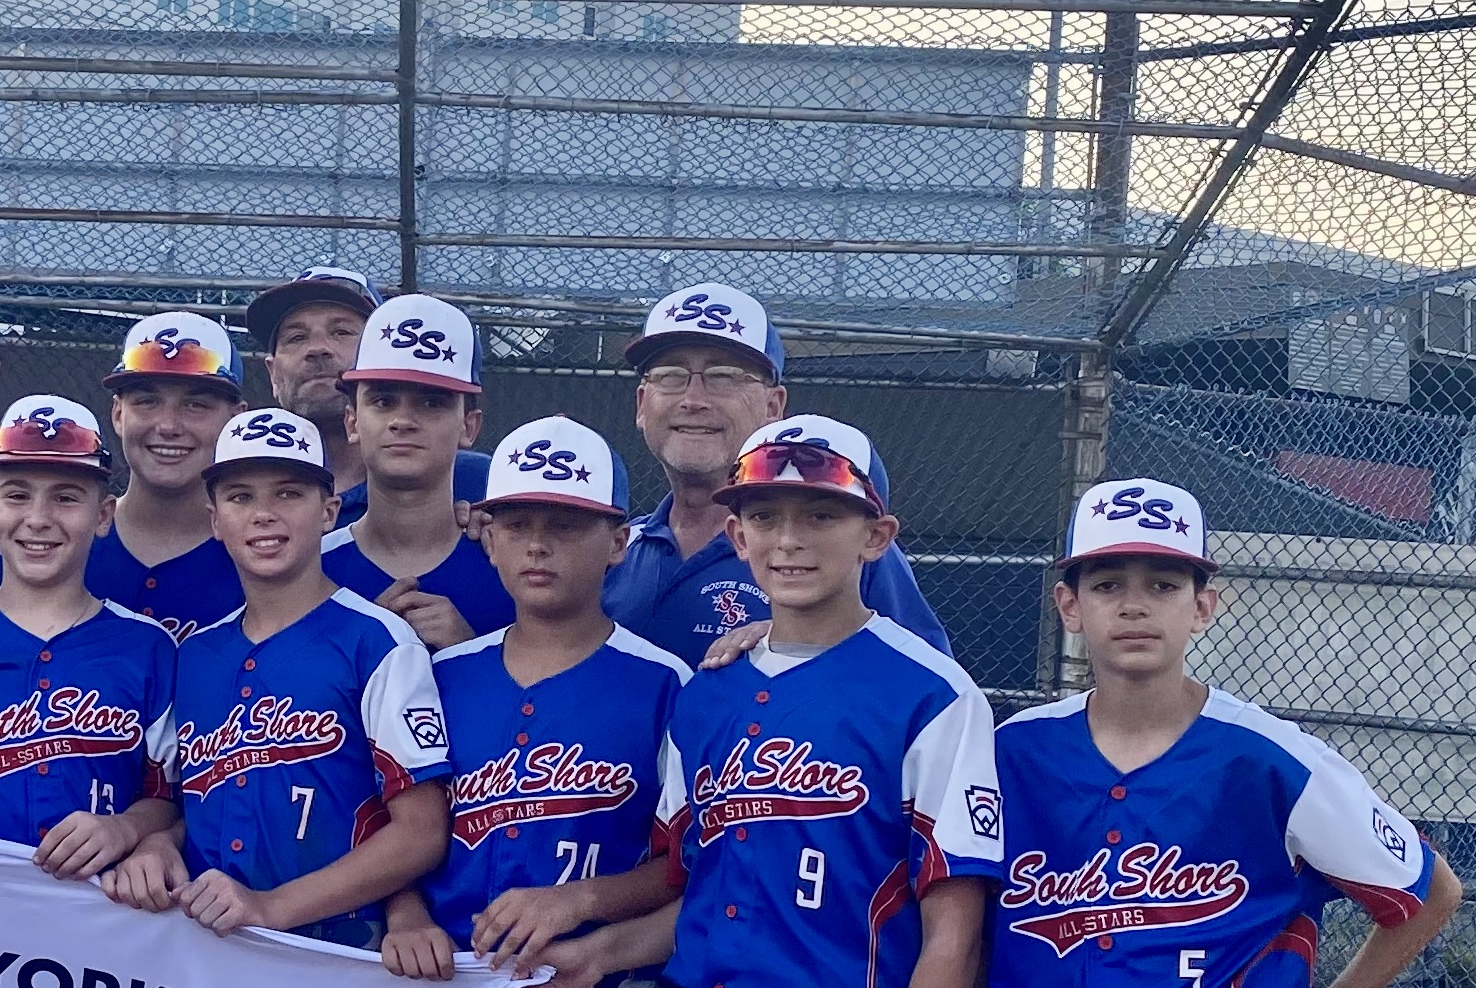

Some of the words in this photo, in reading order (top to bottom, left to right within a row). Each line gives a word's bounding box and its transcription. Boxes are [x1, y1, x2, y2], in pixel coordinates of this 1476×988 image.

[675, 293, 732, 330] SS
[391, 318, 445, 360] SS
[244, 414, 298, 448] SS
[518, 439, 578, 482] SS
[1107, 487, 1173, 530] SS
[700, 581, 738, 595] SOUTH
[693, 623, 714, 634] ALL
[42, 687, 142, 741] Shore
[242, 696, 340, 744] Shore
[517, 743, 634, 793] Shore
[746, 738, 862, 796] Shore
[291, 785, 316, 840] 7
[796, 847, 825, 910] 9
[1111, 842, 1240, 899] Shore
